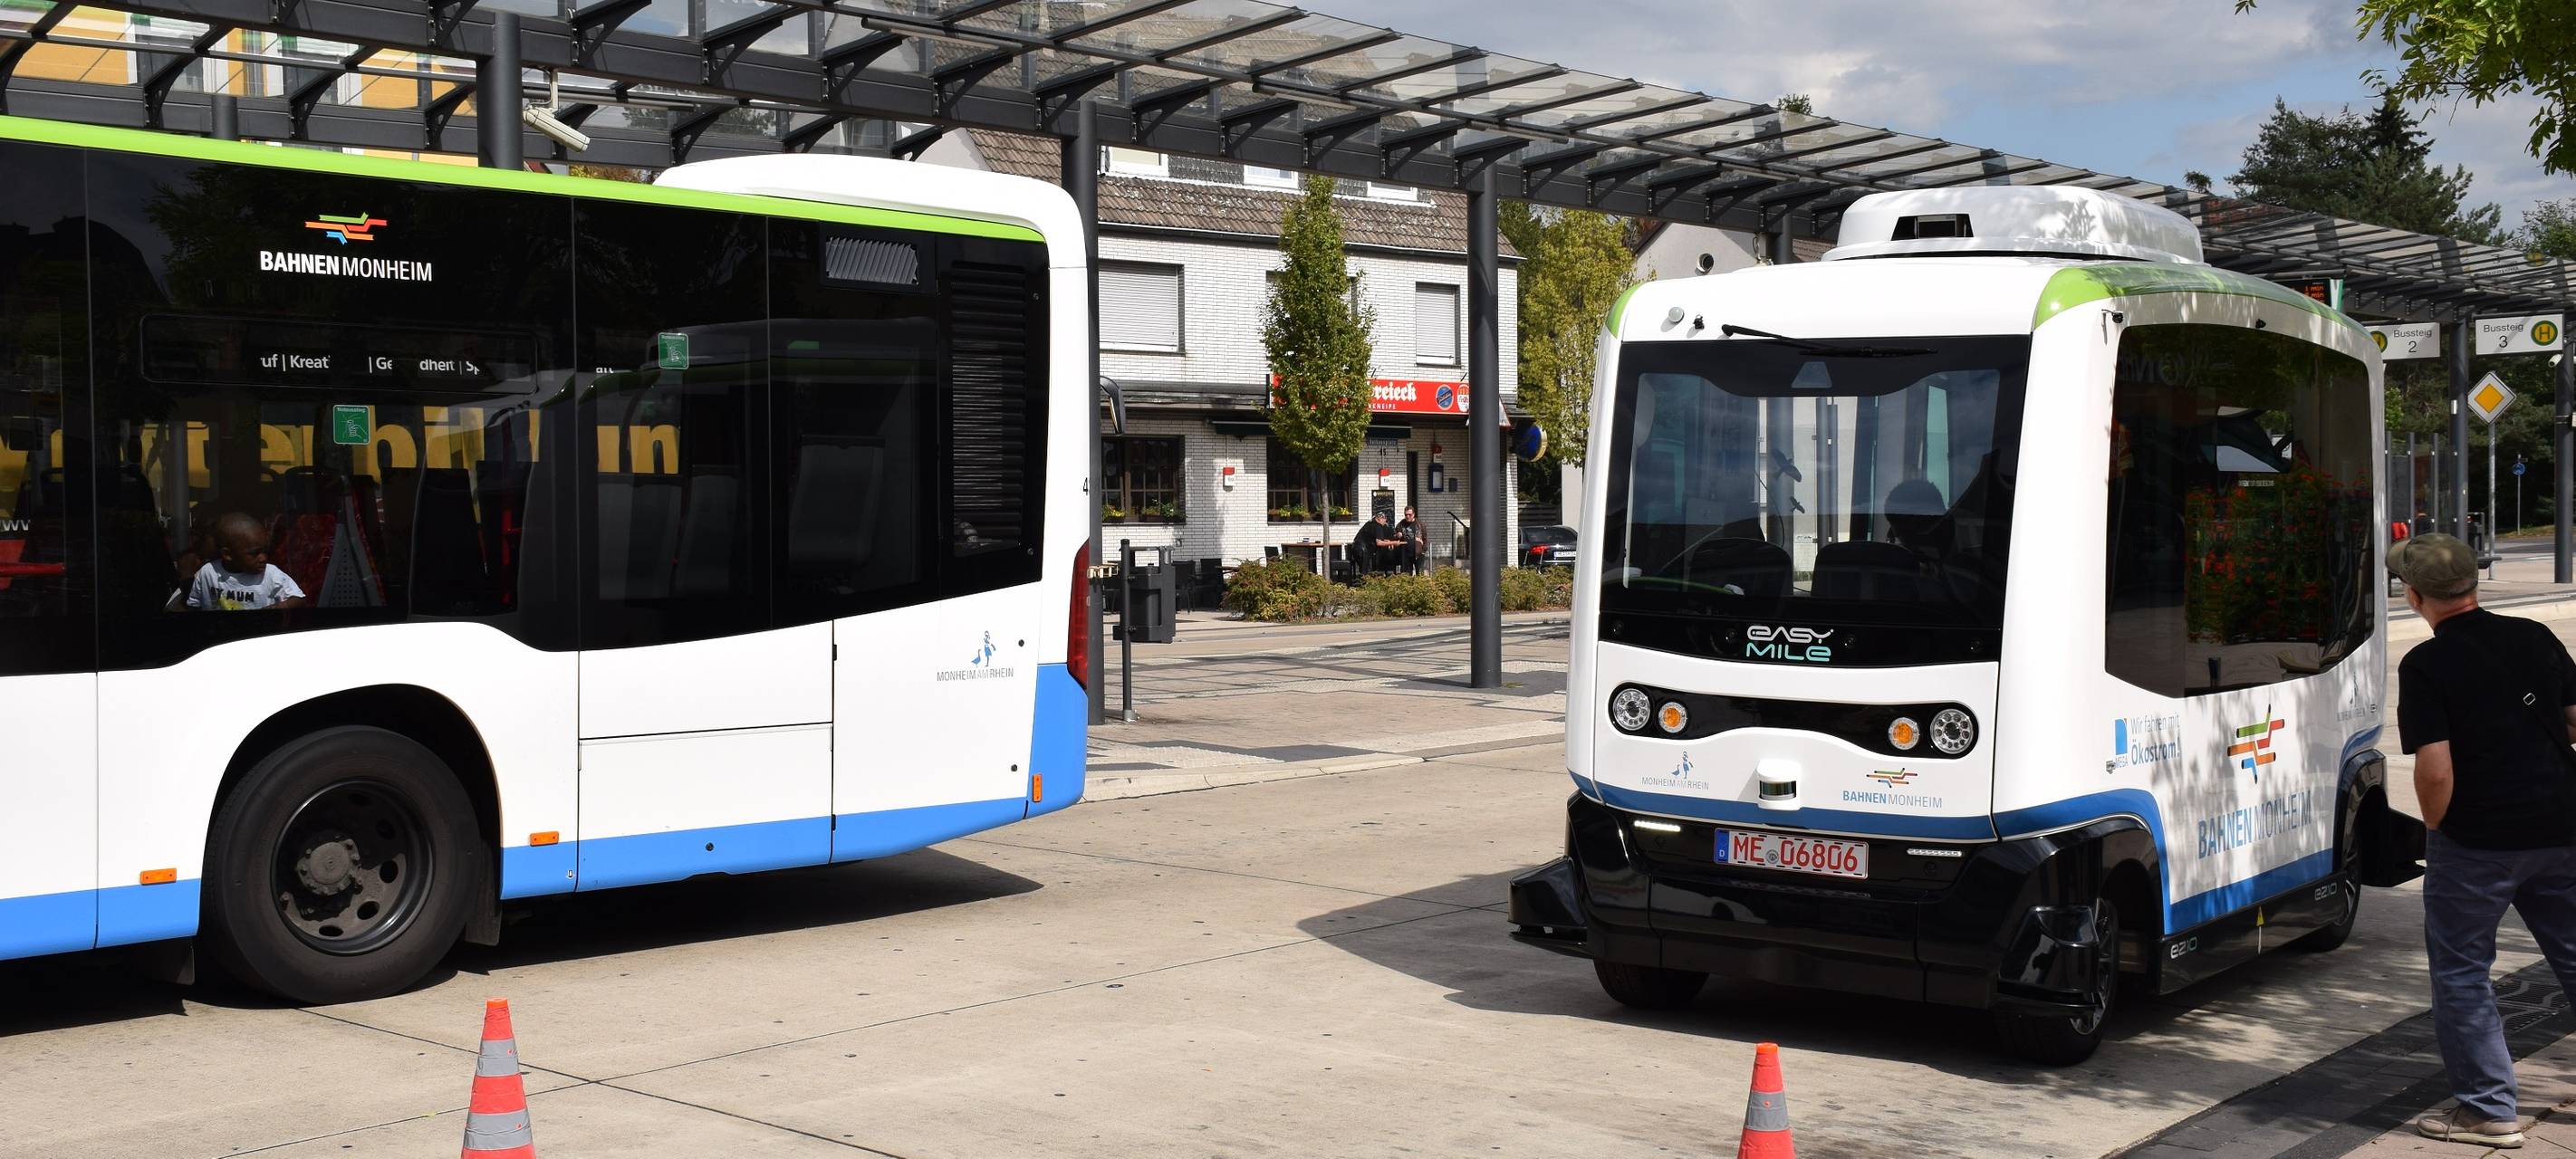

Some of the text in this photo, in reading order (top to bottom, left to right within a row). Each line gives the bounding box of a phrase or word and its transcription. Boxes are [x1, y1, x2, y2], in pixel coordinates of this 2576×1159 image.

[2393, 329, 2432, 338] Bussteig
[2484, 323, 2523, 333] Bussteig
[2408, 340, 2417, 353] 2
[2498, 335, 2508, 348] 3
[261, 354, 278, 368] uf
[1367, 380, 1417, 401] reieck
[226, 589, 255, 602] MUM
[2130, 717, 2143, 734] Wir
[2144, 714, 2167, 733] fahren
[2131, 738, 2180, 766] Ökostrom!
[1719, 835, 1859, 872] D ME 06806
